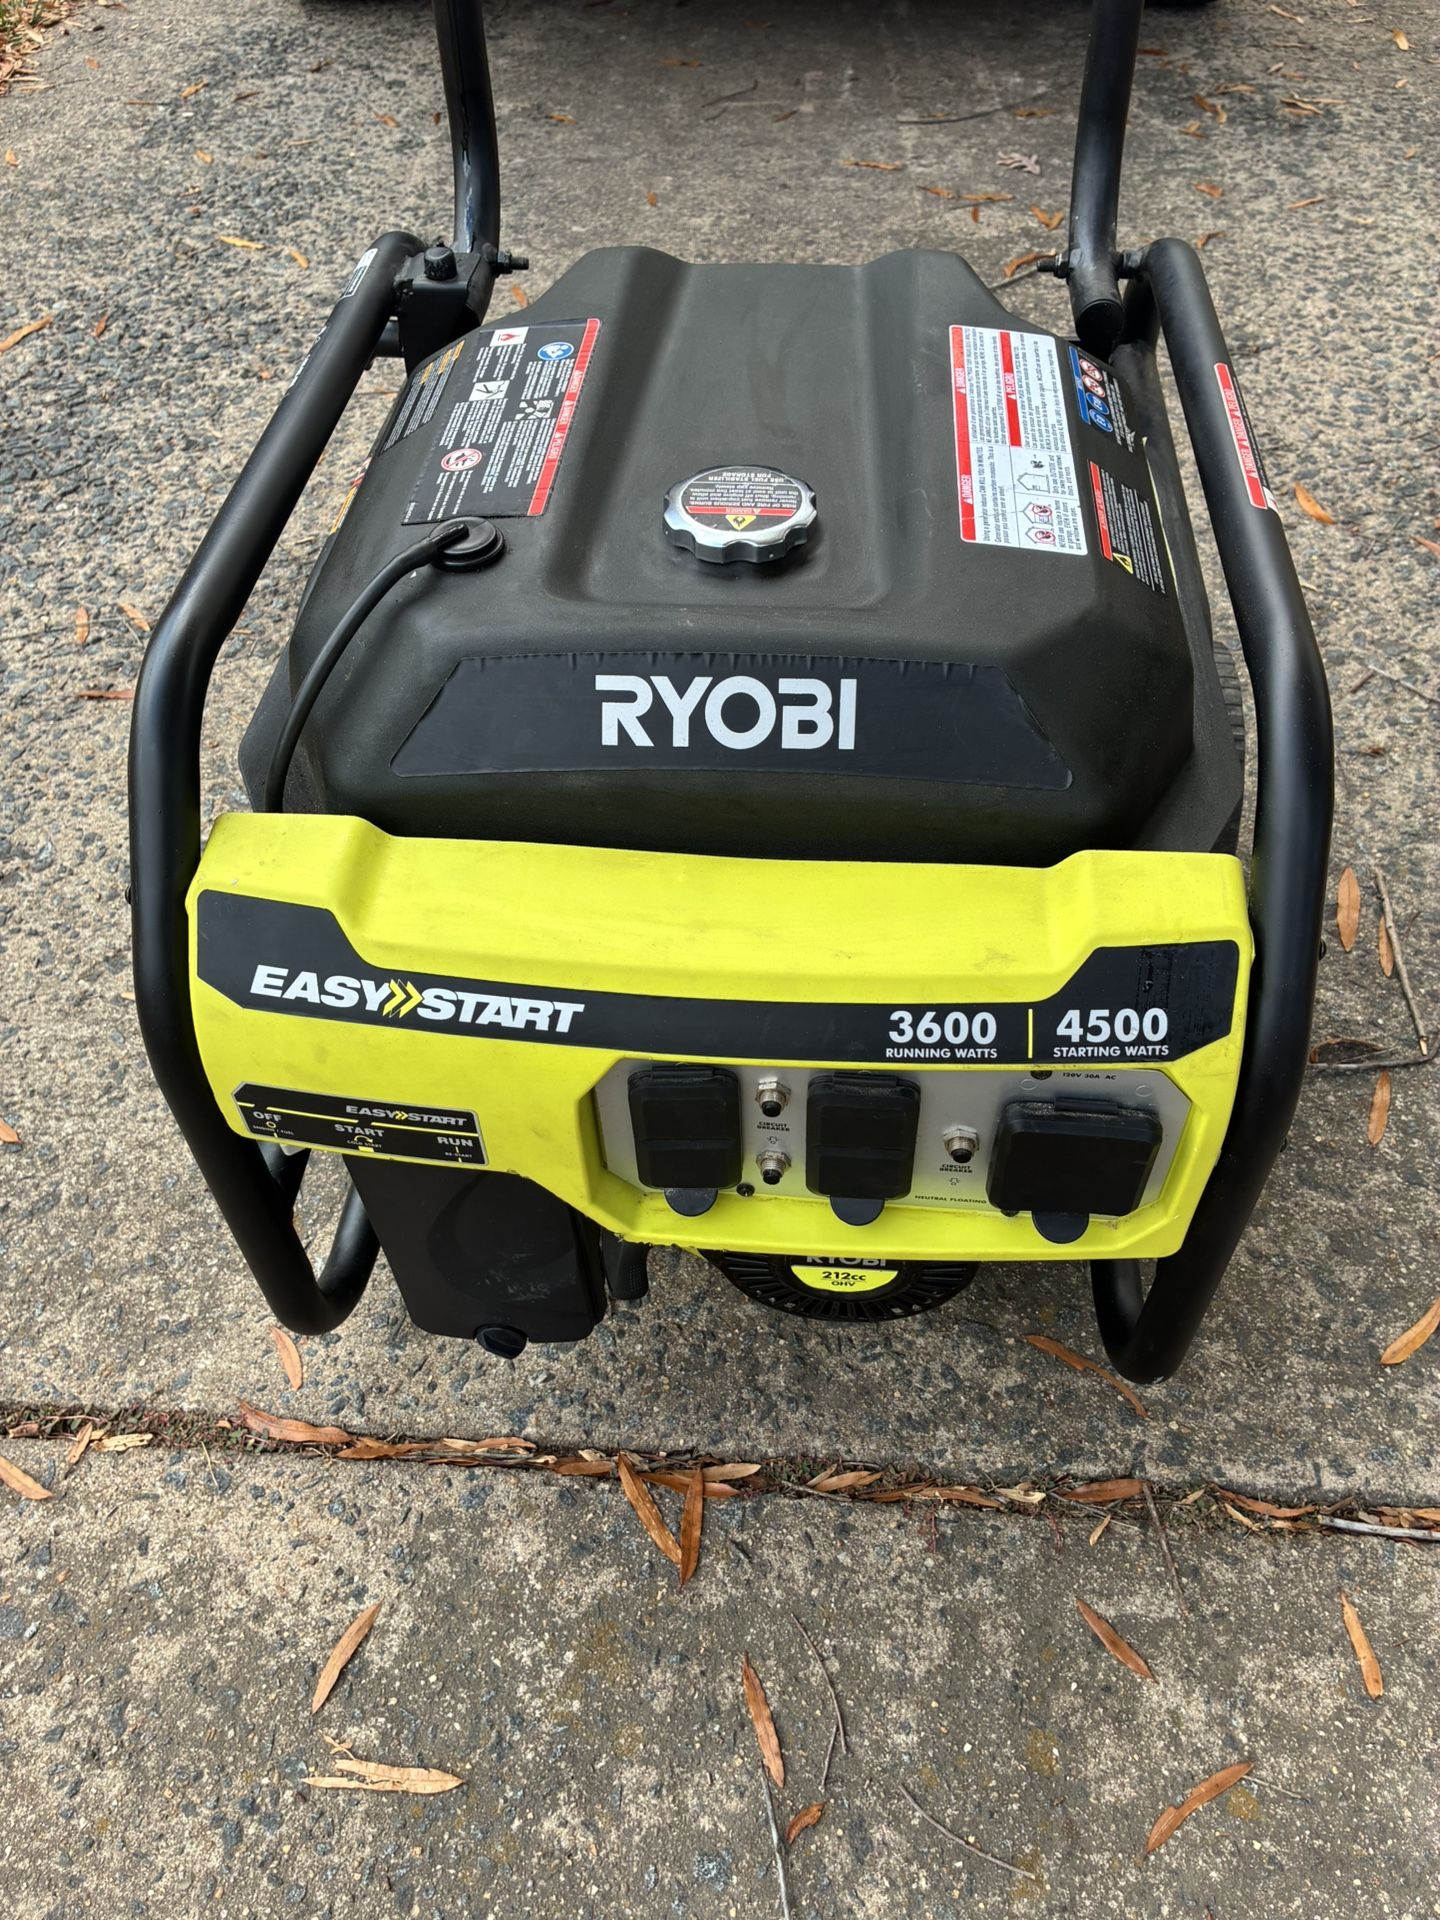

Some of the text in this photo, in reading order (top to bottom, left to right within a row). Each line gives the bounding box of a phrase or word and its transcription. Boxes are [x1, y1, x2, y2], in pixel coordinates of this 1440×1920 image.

[960, 473, 972, 497] DANGER
[595, 674, 857, 750] RYOBI
[888, 1010, 997, 1045] 3600
[1056, 1007, 1169, 1044] 4500
[885, 1047, 998, 1059] RUNNING WATTS
[1053, 1044, 1169, 1058] STARTING WATTS
[252, 1111, 282, 1123] OFF
[334, 1123, 385, 1137] START
[437, 1136, 474, 1148] RUN
[822, 1271, 867, 1282] 212cc
